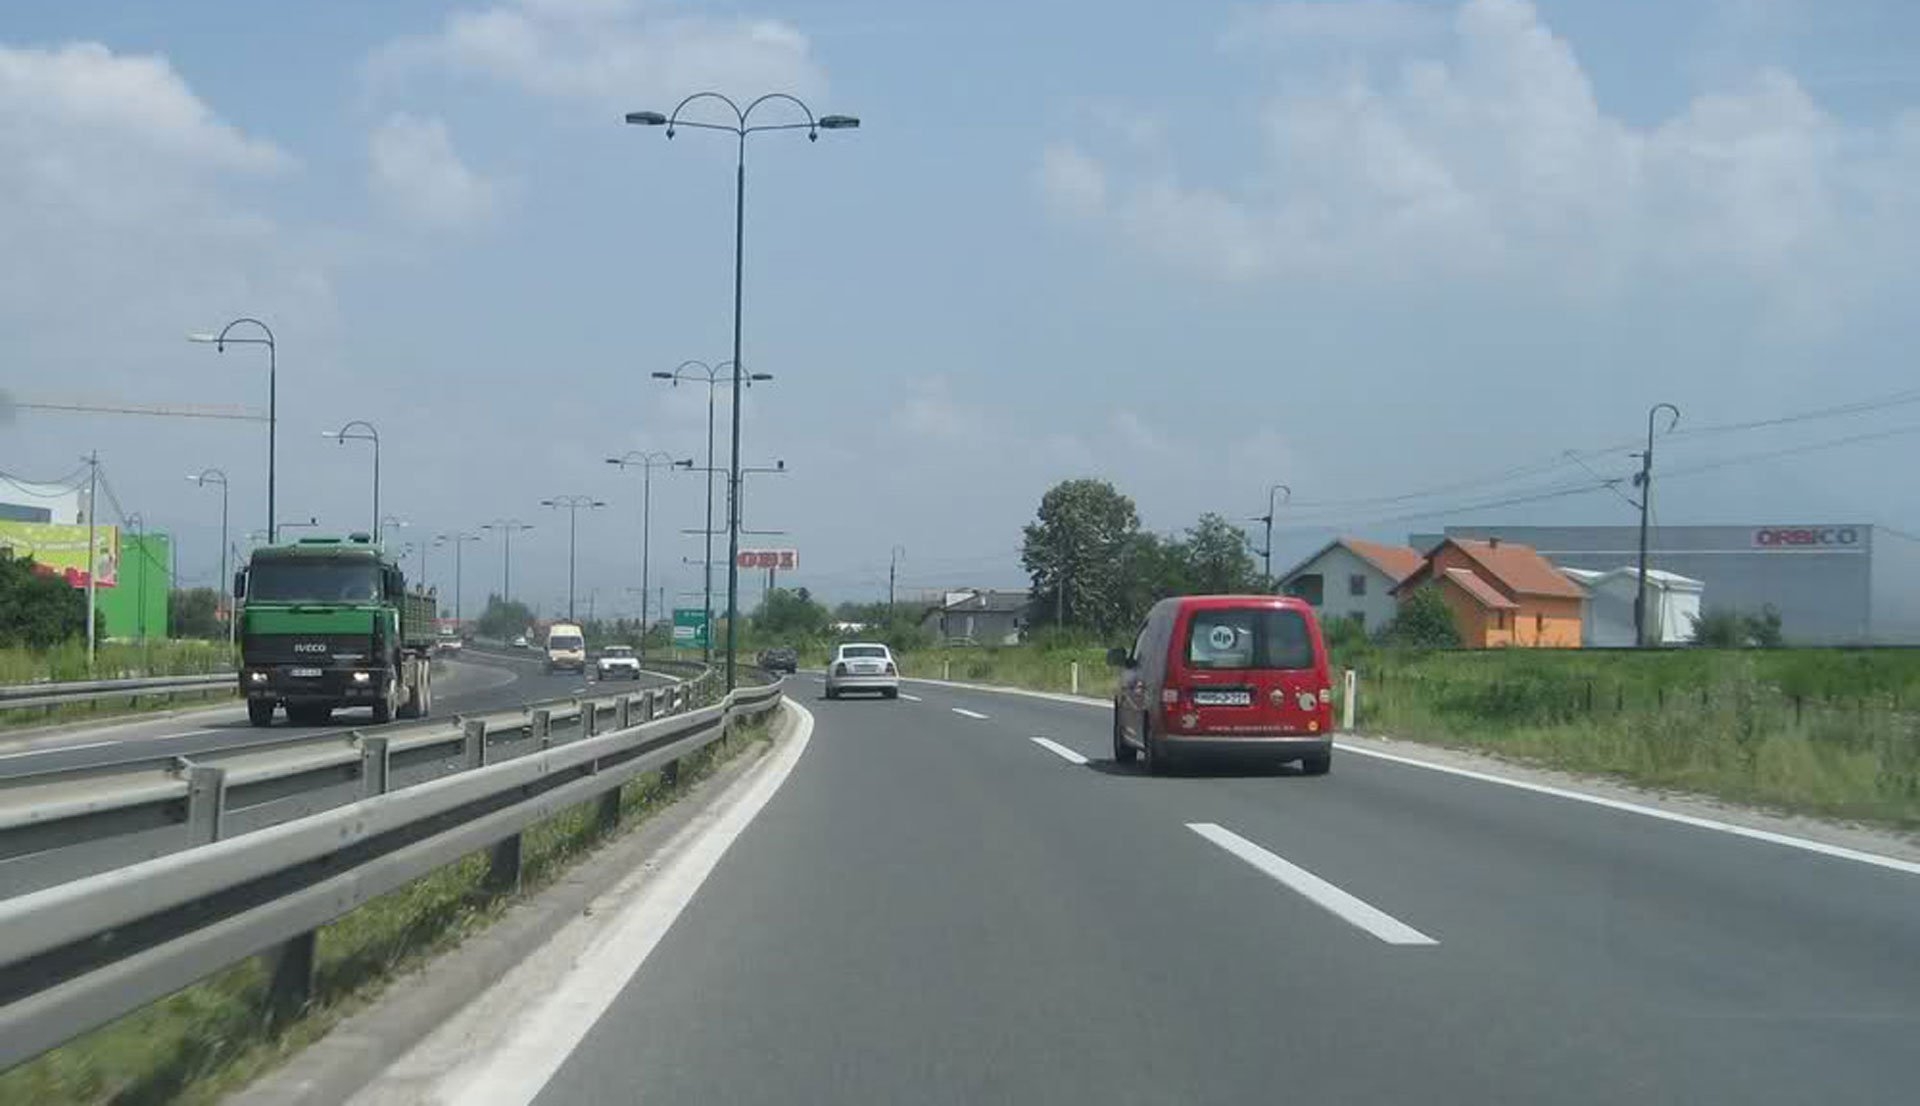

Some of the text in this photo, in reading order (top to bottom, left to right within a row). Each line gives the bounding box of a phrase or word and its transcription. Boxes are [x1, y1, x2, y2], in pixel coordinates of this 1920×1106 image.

[1757, 529, 1856, 544] ORBICO
[737, 552, 793, 567] OBI
[294, 644, 327, 652] IVECO
